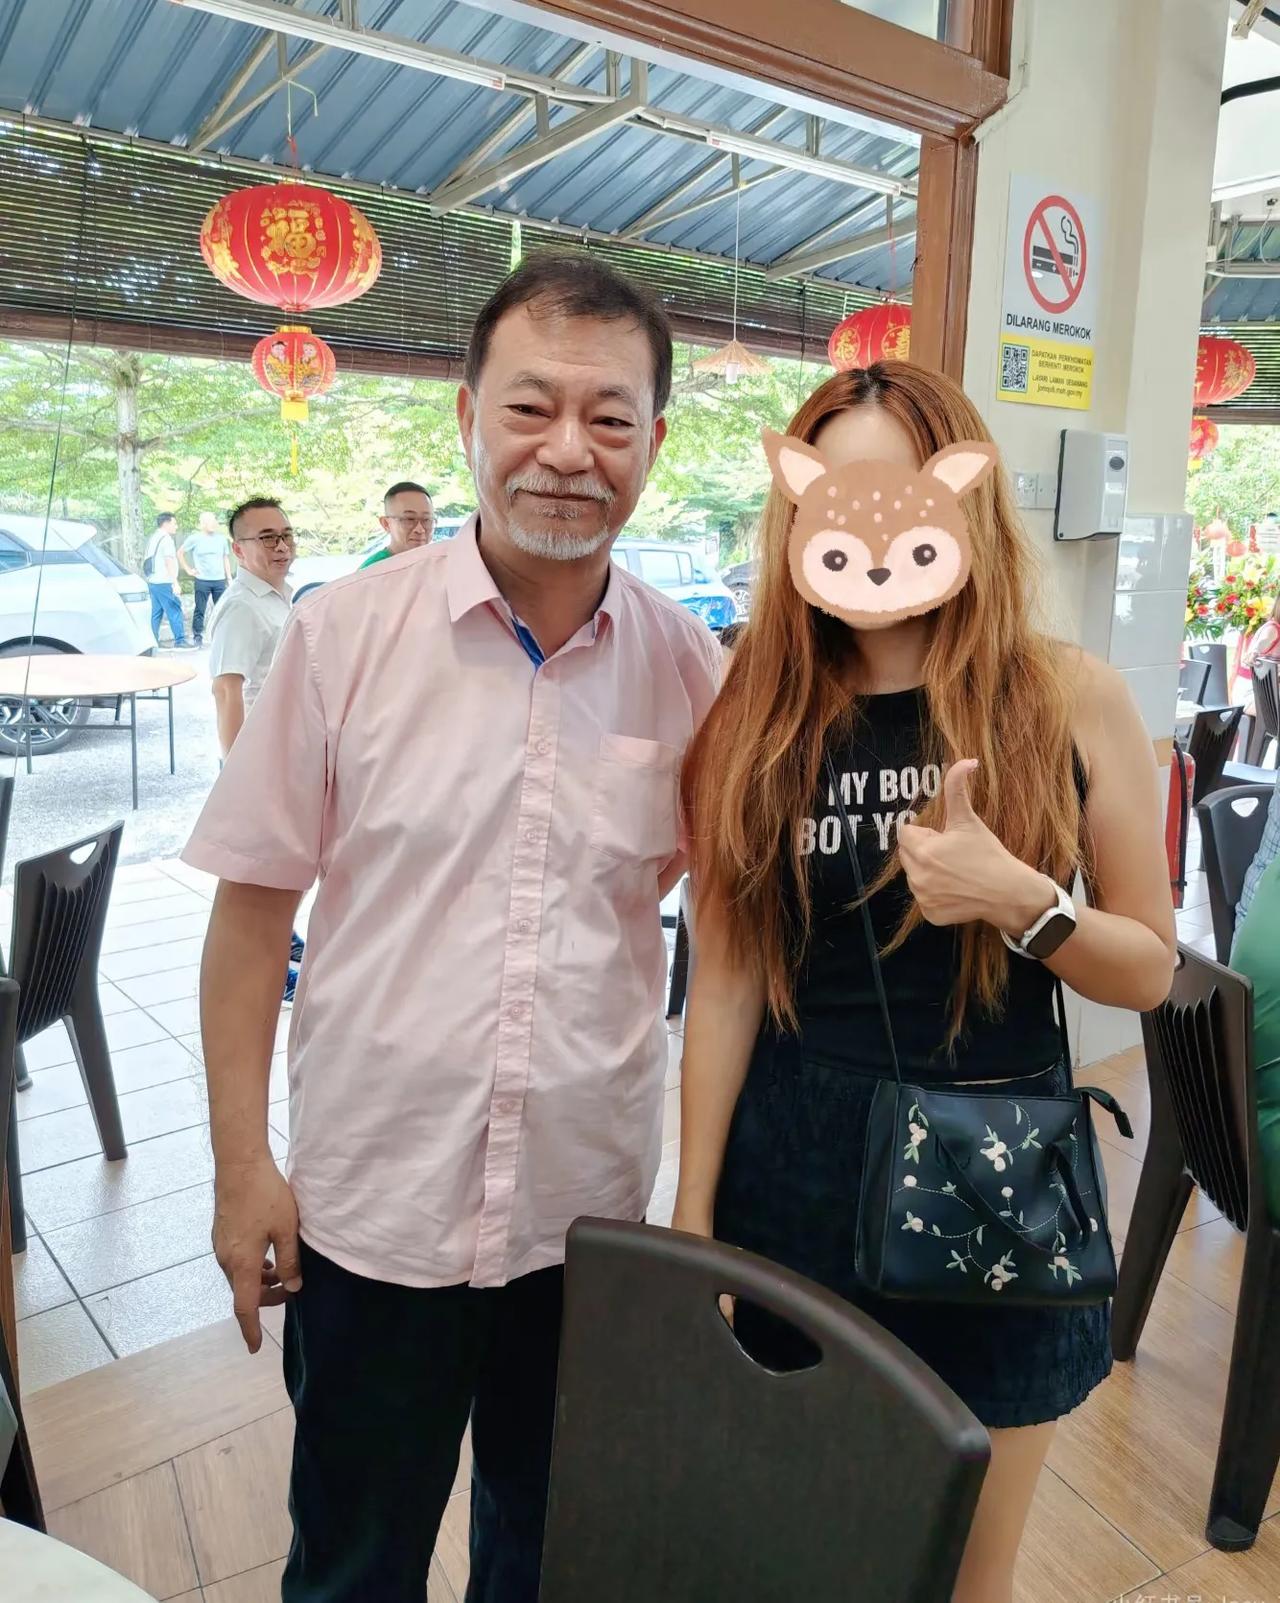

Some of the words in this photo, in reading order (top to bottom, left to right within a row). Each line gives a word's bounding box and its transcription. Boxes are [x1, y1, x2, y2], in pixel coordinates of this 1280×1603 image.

[1006, 313, 1051, 333] DILARANG
[1052, 321, 1092, 341] MEROKOK
[828, 771, 869, 806] MY
[879, 763, 947, 803] BOO
